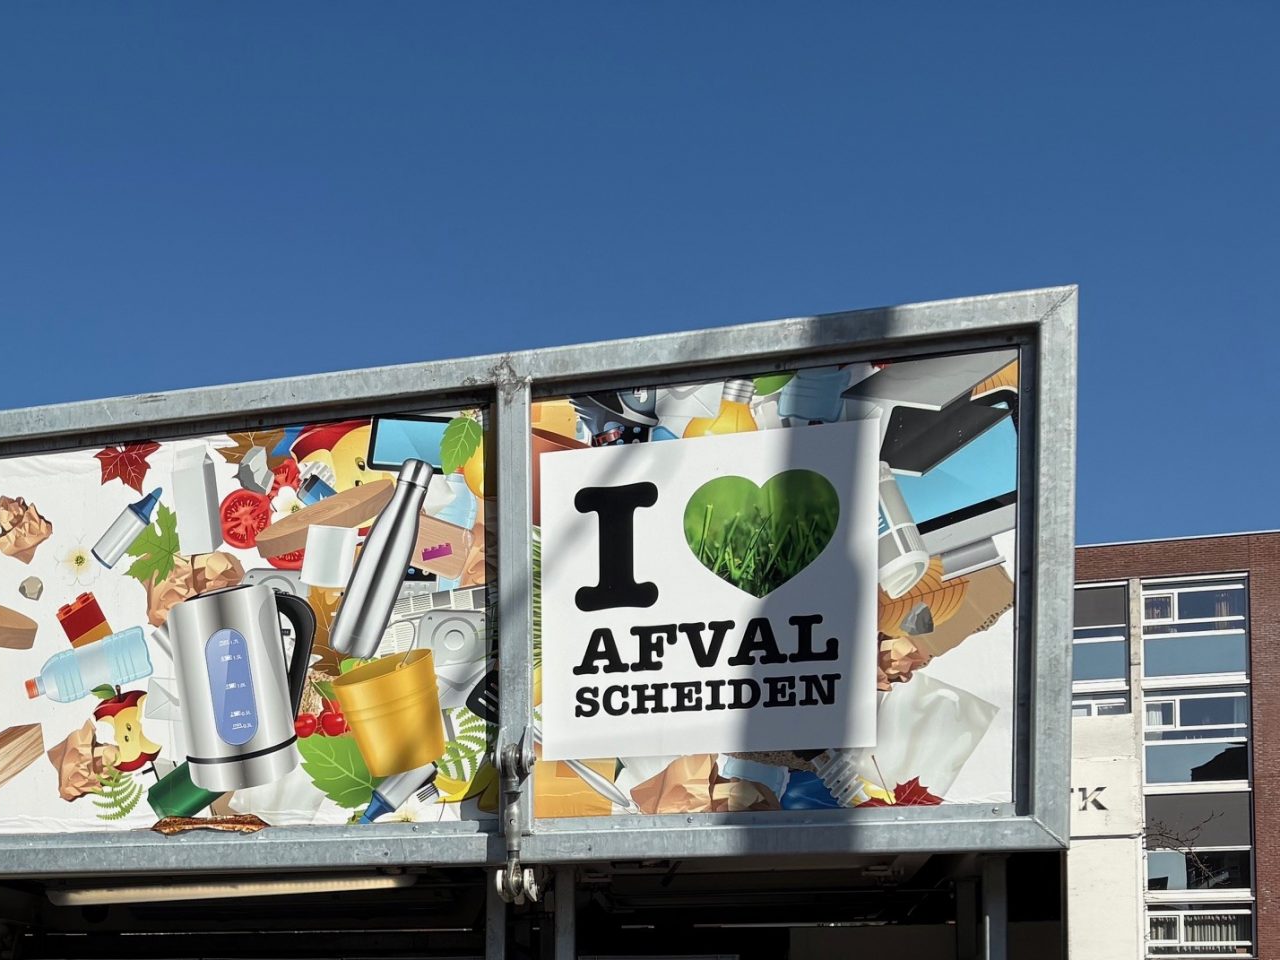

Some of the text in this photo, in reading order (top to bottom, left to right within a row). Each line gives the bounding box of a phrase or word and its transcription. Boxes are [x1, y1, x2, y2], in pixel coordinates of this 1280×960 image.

[574, 481, 659, 612] I
[572, 614, 839, 675] AFVAL
[574, 673, 841, 718] SCHEIDEN
[1070, 786, 1109, 811] K
